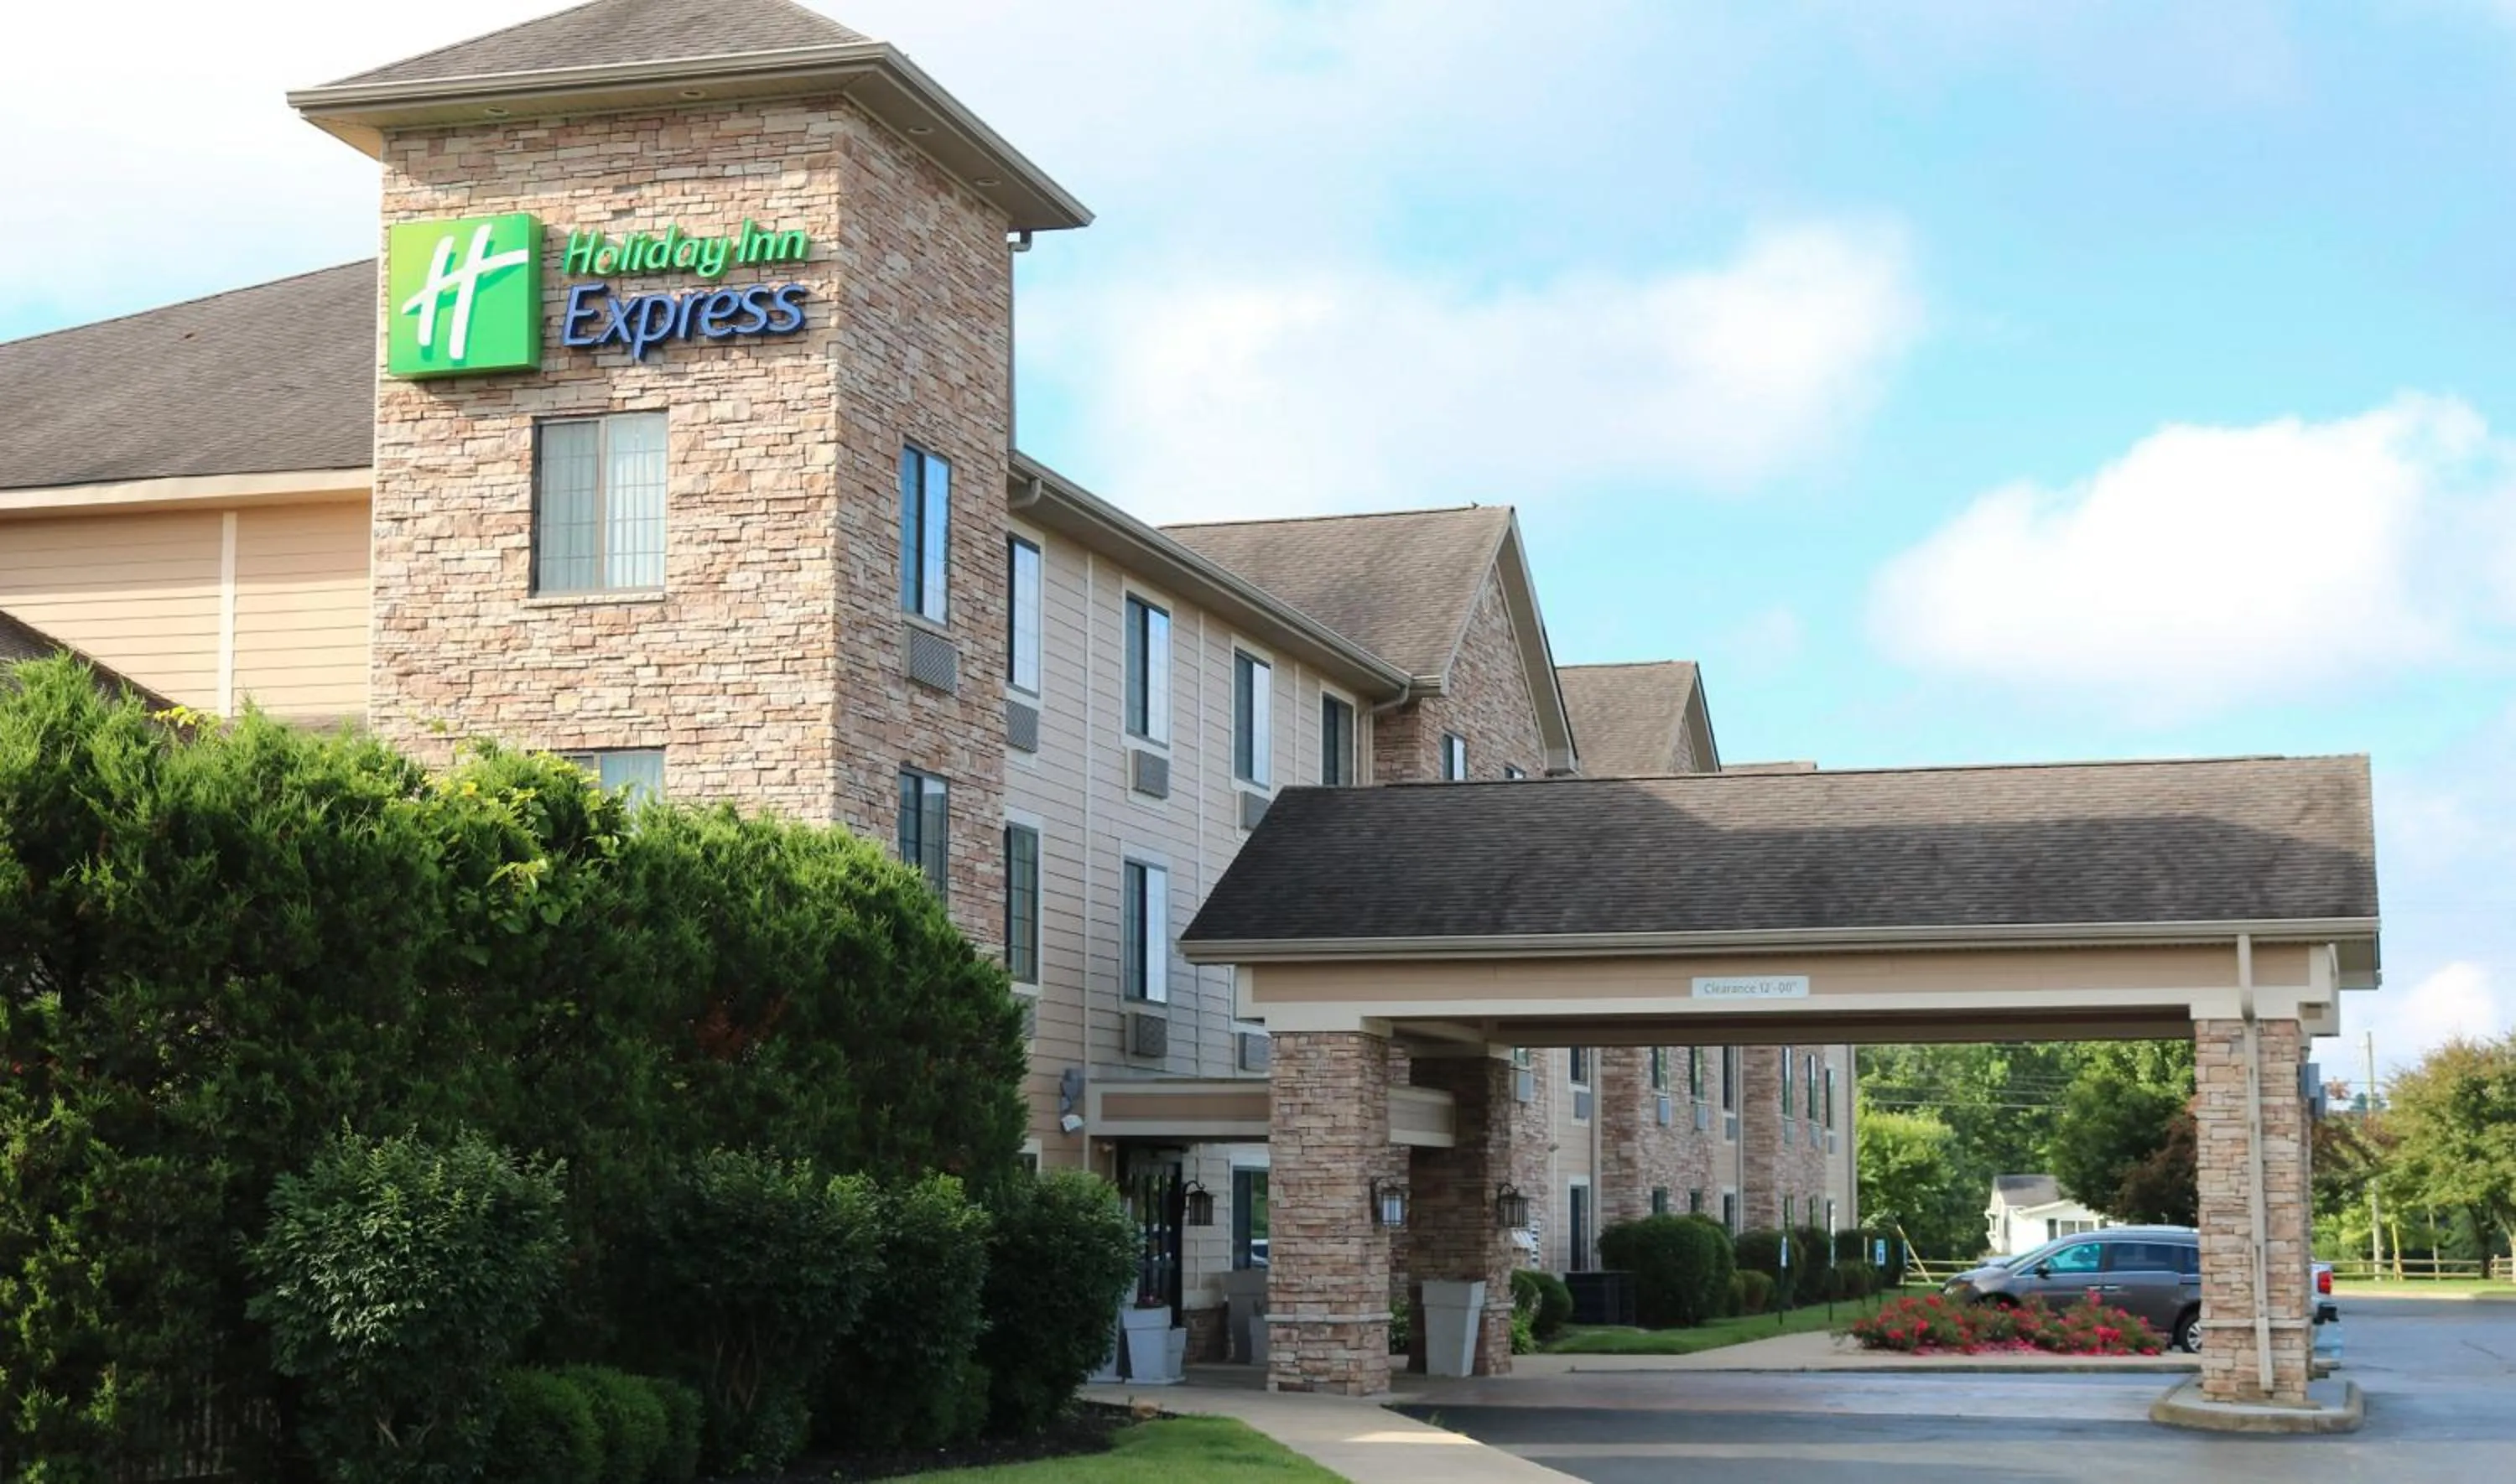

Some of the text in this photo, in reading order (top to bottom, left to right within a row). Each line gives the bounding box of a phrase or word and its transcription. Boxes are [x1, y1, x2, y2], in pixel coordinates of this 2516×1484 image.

[563, 217, 809, 279] Holiday Inn
[561, 282, 808, 361] Express
[1703, 981, 1757, 994] Clearance
